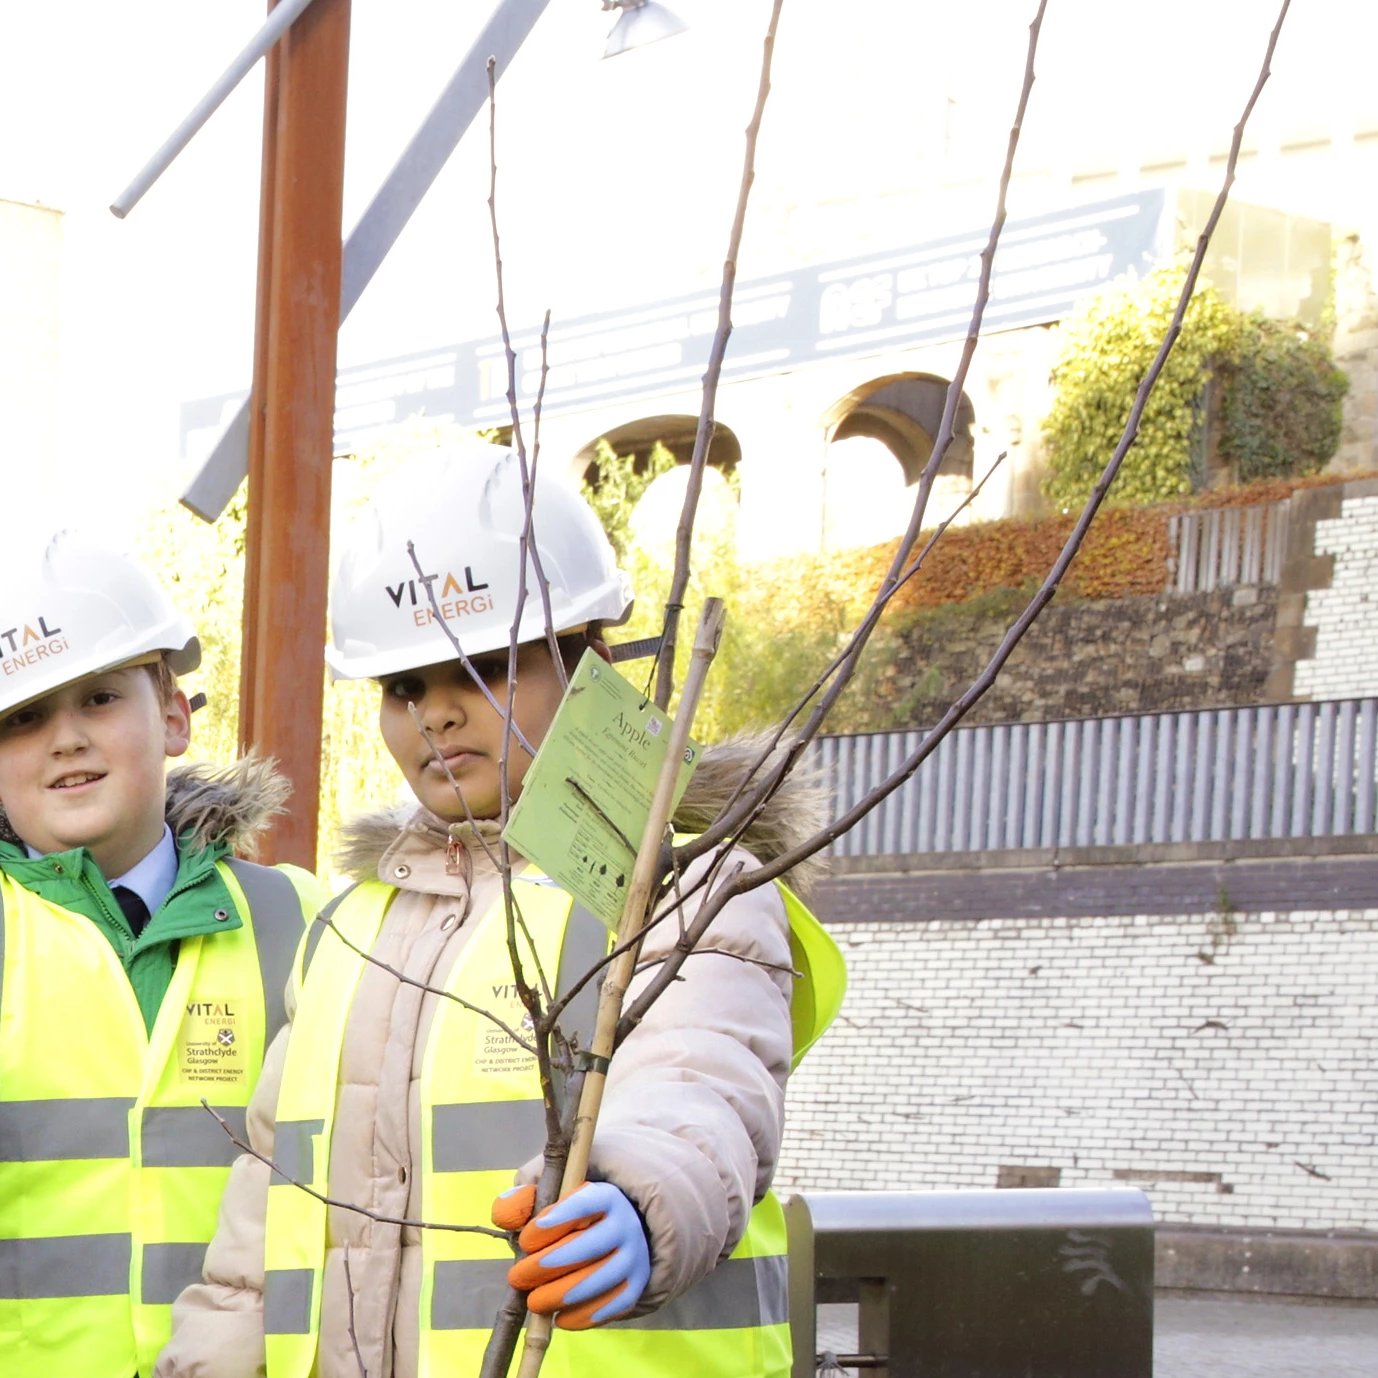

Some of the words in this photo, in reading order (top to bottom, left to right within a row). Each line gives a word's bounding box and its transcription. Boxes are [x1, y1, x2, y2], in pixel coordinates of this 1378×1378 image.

[385, 566, 489, 608] VITAL
[2, 637, 69, 676] ENERGi
[612, 711, 651, 751] Apple
[186, 1003, 235, 1016] VITAL
[485, 1033, 537, 1045] Strathlyd
[187, 1048, 237, 1057] Strathclyde
[484, 1046, 518, 1054] Glasgow
